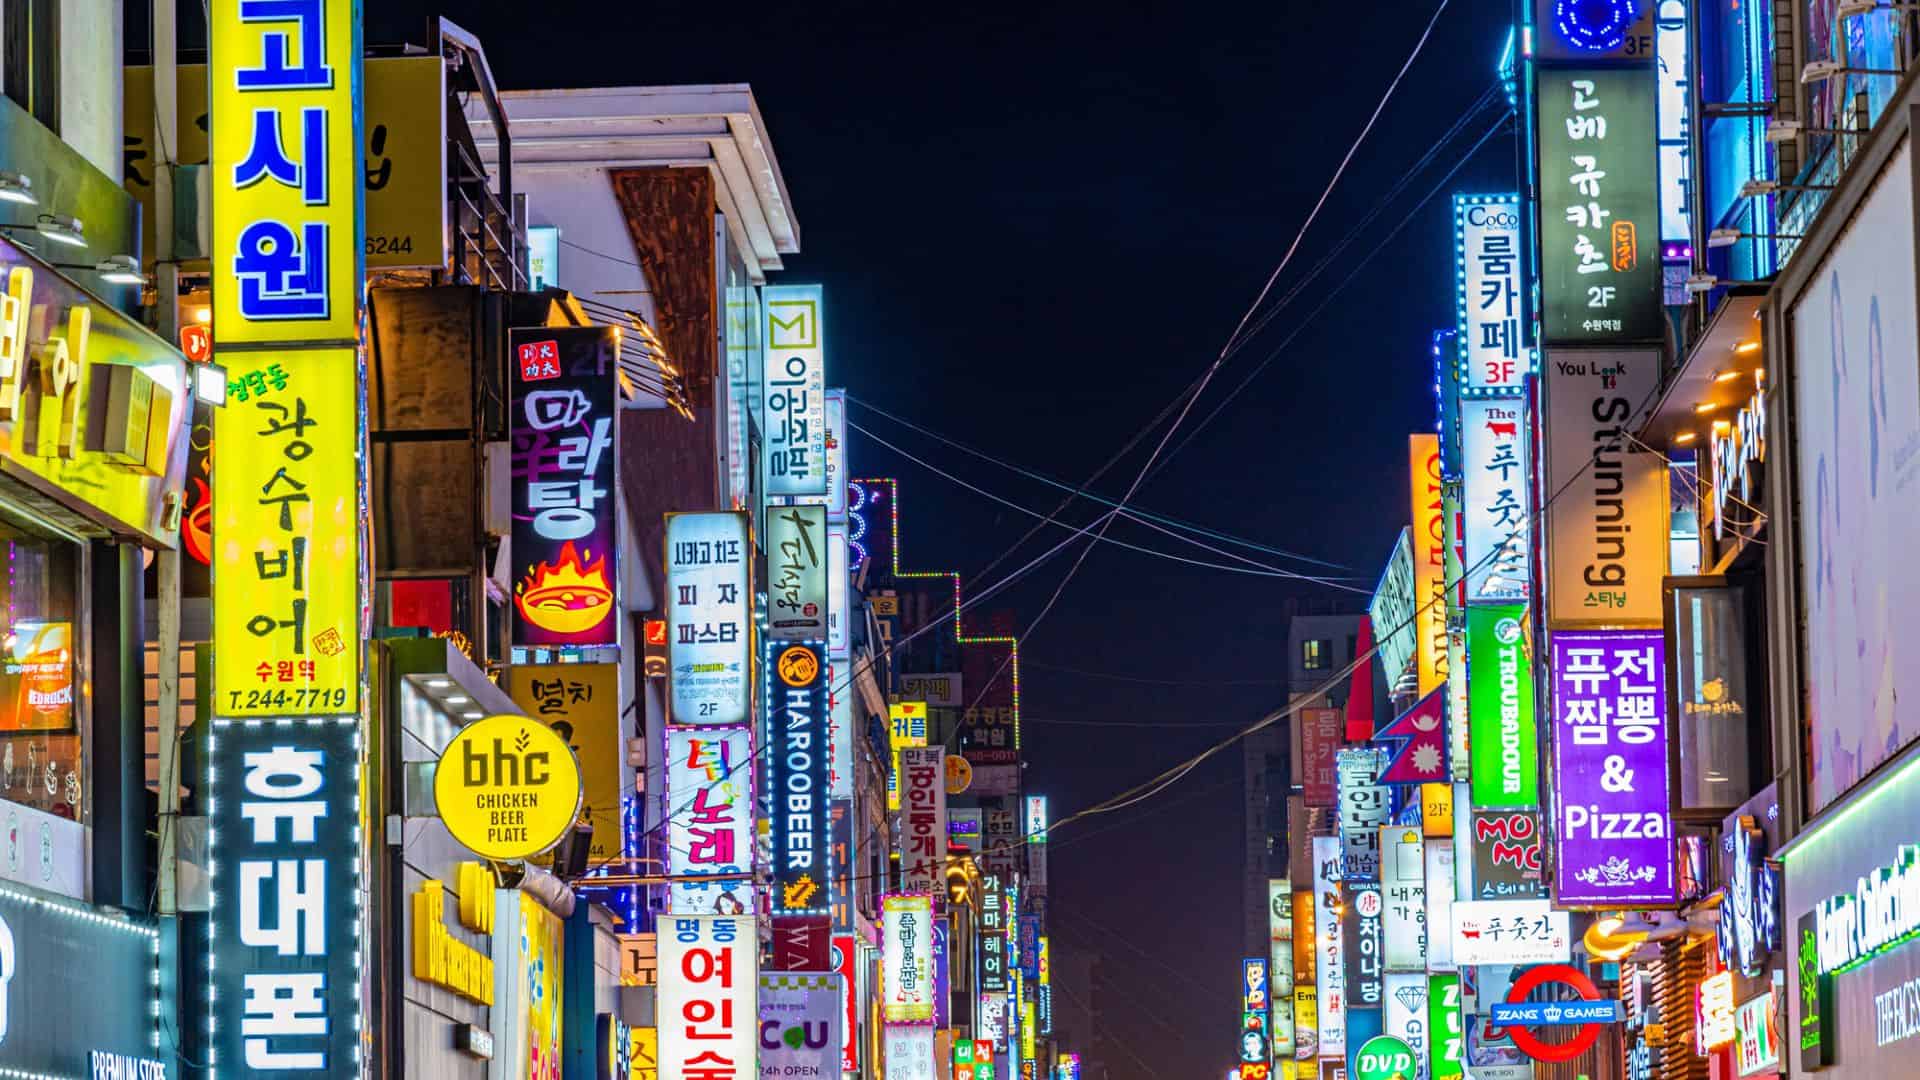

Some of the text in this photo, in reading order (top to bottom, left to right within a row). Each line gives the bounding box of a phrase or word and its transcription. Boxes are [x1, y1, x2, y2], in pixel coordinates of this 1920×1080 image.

[235, 0, 334, 321] 고시원
[1566, 80, 1611, 274] 고베 규카츠
[1468, 207, 1518, 228] CoCo
[1478, 236, 1519, 359] 룸카페
[1588, 287, 1616, 308] 2F
[1485, 362, 1516, 384] 3F
[1557, 362, 1587, 377] You
[769, 356, 809, 480] 이공족발
[1485, 408, 1517, 420] The
[524, 389, 612, 541] 마라탕
[1584, 397, 1631, 587] Stunning
[246, 397, 319, 655] 광수비어
[674, 540, 740, 566] 시카고 치즈
[678, 622, 740, 645] 파스타
[256, 661, 315, 682] 수원역
[1563, 646, 1657, 695] 퓨전
[532, 679, 592, 714] 멸치
[699, 703, 718, 717] 2F
[893, 717, 925, 738] 커플
[1499, 645, 1521, 794] TROUBADOUR
[1564, 695, 1660, 745] 짬뽕
[463, 739, 549, 788] bhc
[1599, 755, 1635, 793] &
[784, 689, 813, 869] HAROOBEER
[477, 792, 538, 808] CHICKEN
[1428, 803, 1448, 817] 2F
[490, 811, 525, 826] BEER
[1566, 804, 1664, 840] Pizza
[488, 827, 529, 843] PLATE
[240, 746, 328, 1069] 휴대폰
[983, 875, 1002, 930] 가르마
[676, 918, 737, 944] 명동
[1484, 915, 1554, 943] 푸줏간
[984, 936, 1002, 975] 헤어
[1360, 918, 1381, 1003] 차이나당
[1564, 1006, 1614, 1019] GAMES
[784, 1065, 818, 1077] OPEN
[1241, 1064, 1267, 1079] PC
[1361, 1054, 1411, 1073] DVD
